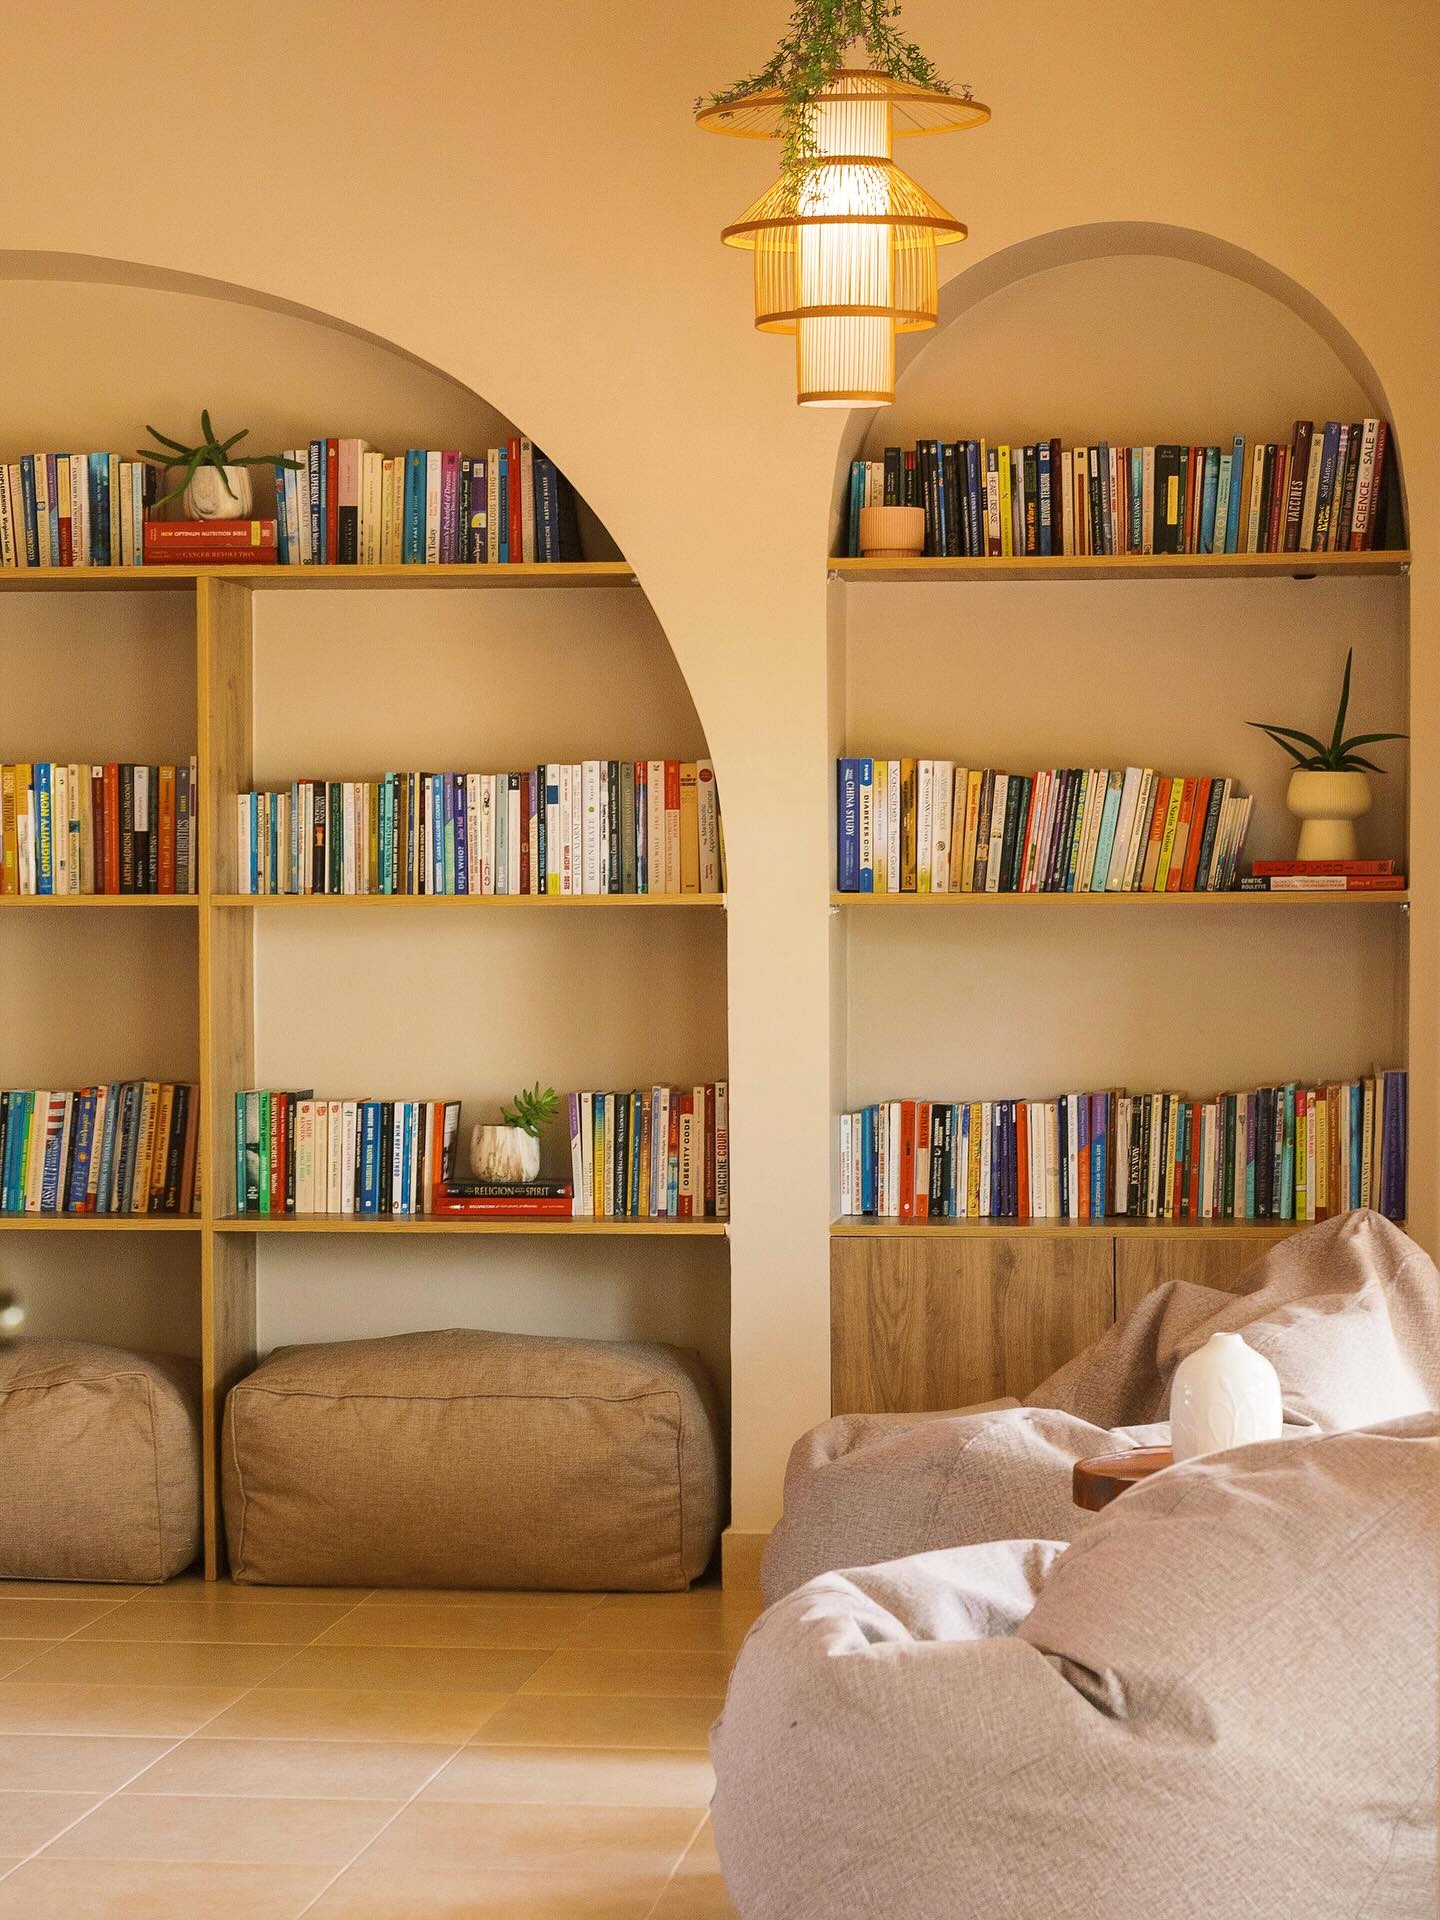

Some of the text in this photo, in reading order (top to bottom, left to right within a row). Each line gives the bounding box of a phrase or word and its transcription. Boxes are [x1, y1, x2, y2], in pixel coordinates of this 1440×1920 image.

[311, 445, 320, 473] SHAMANIC
[311, 474, 320, 505] EXPERIENCE
[1320, 485, 1329, 498] Self
[1355, 437, 1375, 529] SCIENCE SALE
[1040, 473, 1050, 526] NERVOUS TENSION
[1287, 480, 1304, 522] VACCINES
[428, 528, 437, 551] Today
[1027, 502, 1036, 550] Water Wars
[846, 781, 855, 807] CHINA
[890, 767, 899, 823] Vaccines
[40, 791, 51, 877] LONGEVITY NOW
[706, 790, 715, 853] Approach Cancer
[846, 809, 855, 837] STUDY
[123, 832, 132, 863] MEDICINE
[177, 819, 189, 865] ANTIBIOTICS
[123, 864, 132, 885] EARTH
[716, 1127, 727, 1157] COURT
[474, 1187, 549, 1196] RELIGION SPIRIT
[717, 1158, 727, 1196] VACCINE
